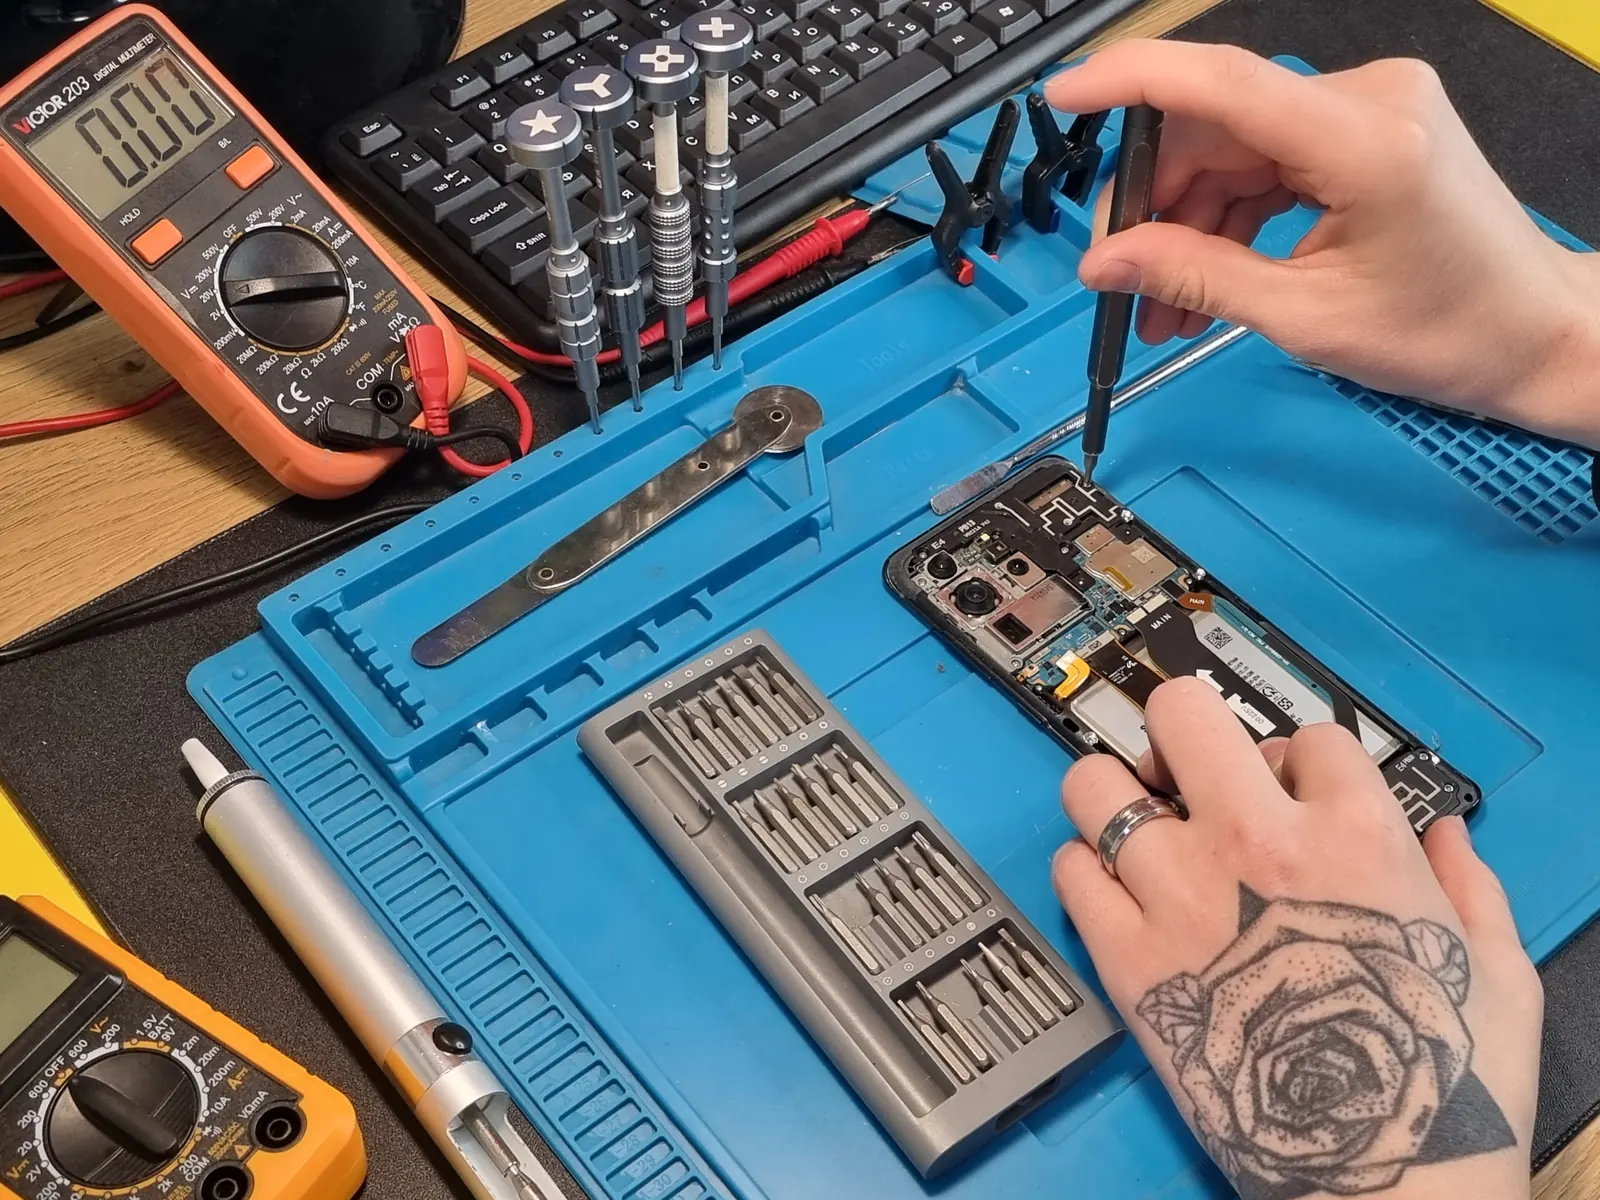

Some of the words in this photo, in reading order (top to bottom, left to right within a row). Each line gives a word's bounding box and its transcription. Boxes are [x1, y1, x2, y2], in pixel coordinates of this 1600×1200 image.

[582, 9, 595, 18] F4
[742, 6, 756, 15] U
[660, 19, 670, 27] 6
[542, 30, 556, 40] F3
[951, 34, 966, 45] Alt
[93, 60, 120, 82] DIGITAL
[117, 32, 157, 64] MULTIMETER
[499, 52, 514, 62] F2
[456, 74, 470, 84] F1
[806, 65, 822, 76] N
[535, 88, 546, 97] 3
[13, 94, 68, 135] VICTOR
[62, 75, 91, 104] 203
[490, 111, 502, 120] 2
[362, 121, 382, 135] Esc
[626, 119, 641, 130] D
[432, 181, 450, 194] Tab
[118, 207, 142, 227] HOLD
[245, 208, 263, 225] 500V
[268, 204, 286, 221] 200V
[291, 209, 307, 224] 2mA
[469, 211, 490, 226] Caps
[489, 200, 509, 215] Lock
[222, 224, 238, 239] OFF
[311, 215, 332, 235] 20mA
[331, 229, 354, 250] 200mA
[526, 231, 547, 247] Shift
[201, 243, 220, 261] 500V
[345, 255, 360, 268] 10A
[195, 266, 213, 283] 200V
[199, 289, 214, 303] 20V
[209, 308, 221, 321] 2V
[387, 312, 408, 331] mA
[213, 328, 237, 351] 200mV
[356, 362, 385, 391] COM
[931, 538, 946, 550] E4
[1150, 613, 1173, 630] MAIN
[101, 1023, 121, 1043] 200
[135, 1013, 158, 1036] 1.5V
[147, 1013, 175, 1040] BATT
[161, 1026, 177, 1042] 9V
[182, 1034, 200, 1051] 2m
[68, 1039, 89, 1059] 600
[198, 1045, 220, 1067] 20m
[44, 1055, 67, 1078] OFF
[208, 1059, 236, 1088] 200m
[28, 1079, 49, 1099] 600
[210, 1096, 231, 1114] 10A
[17, 1109, 37, 1130] 200
[17, 1141, 33, 1157] 20
[179, 1154, 199, 1175] 200
[185, 1156, 210, 1182] COM
[26, 1164, 42, 1183] 2V
